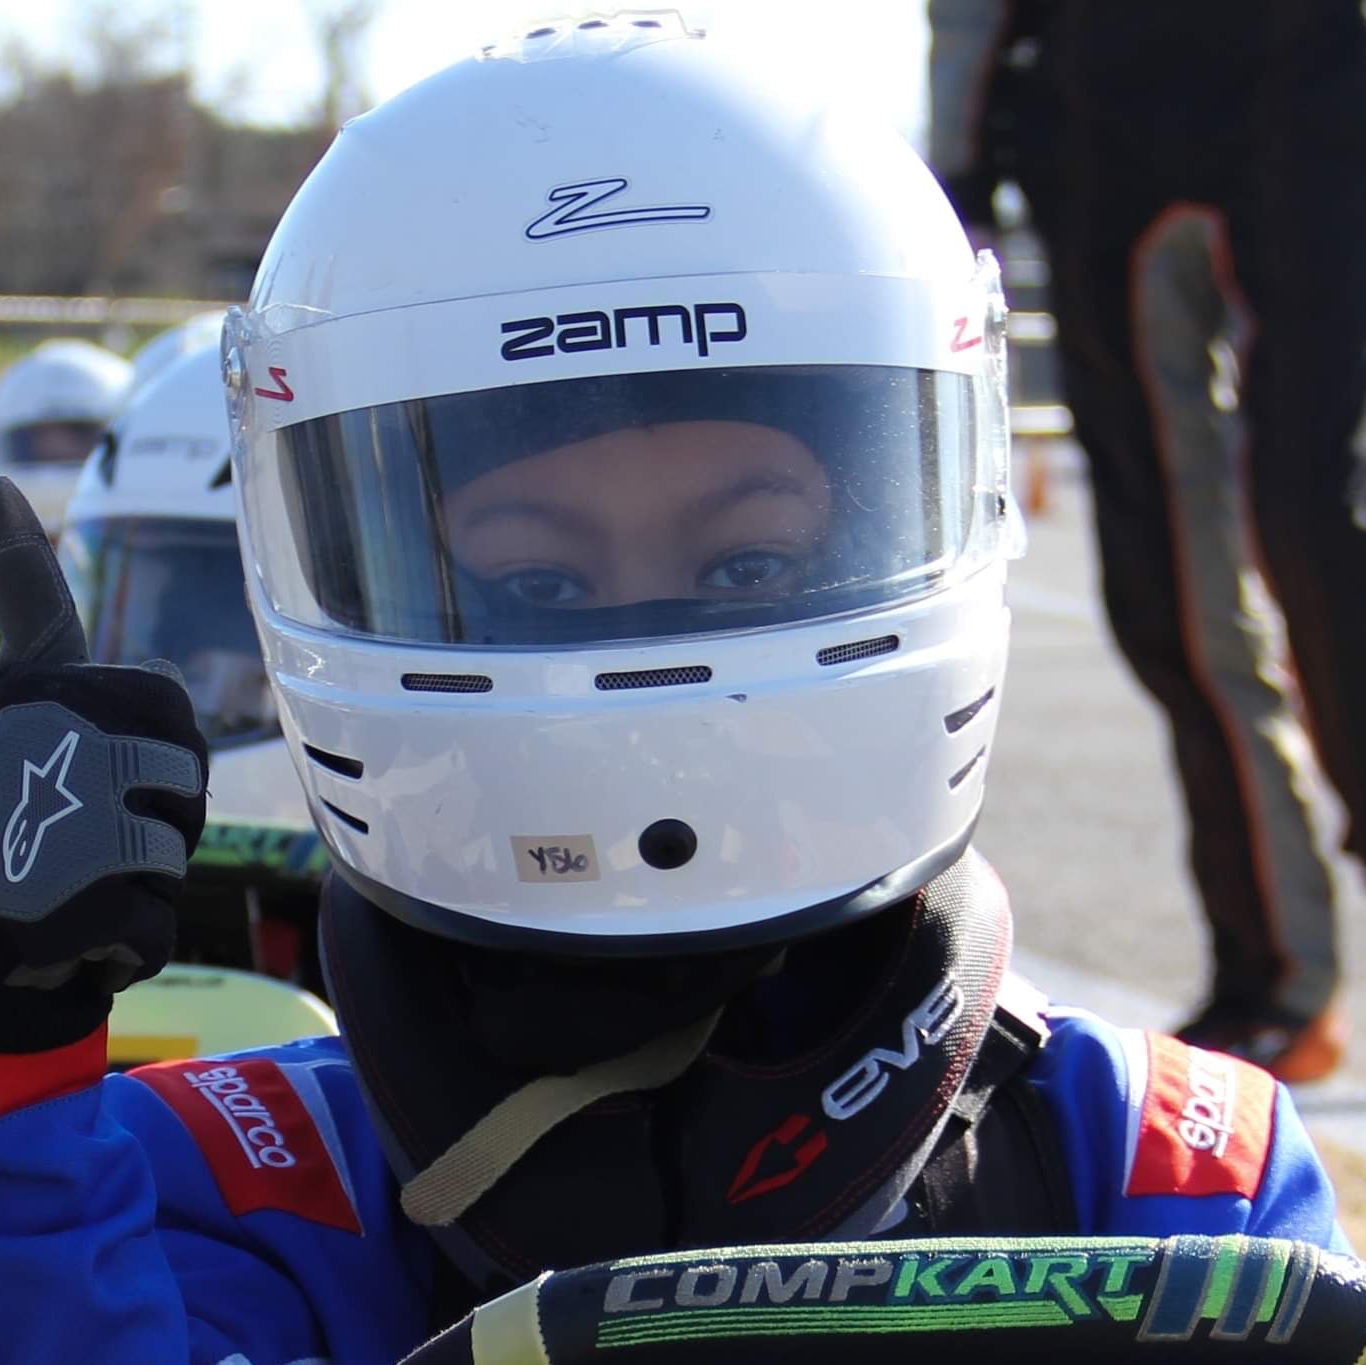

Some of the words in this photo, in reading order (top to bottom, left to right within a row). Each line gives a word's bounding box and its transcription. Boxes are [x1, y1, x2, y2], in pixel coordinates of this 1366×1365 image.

[501, 303, 747, 361] zamp
[185, 1066, 296, 1171] sparco
[603, 1250, 1153, 1320] COMPKART
